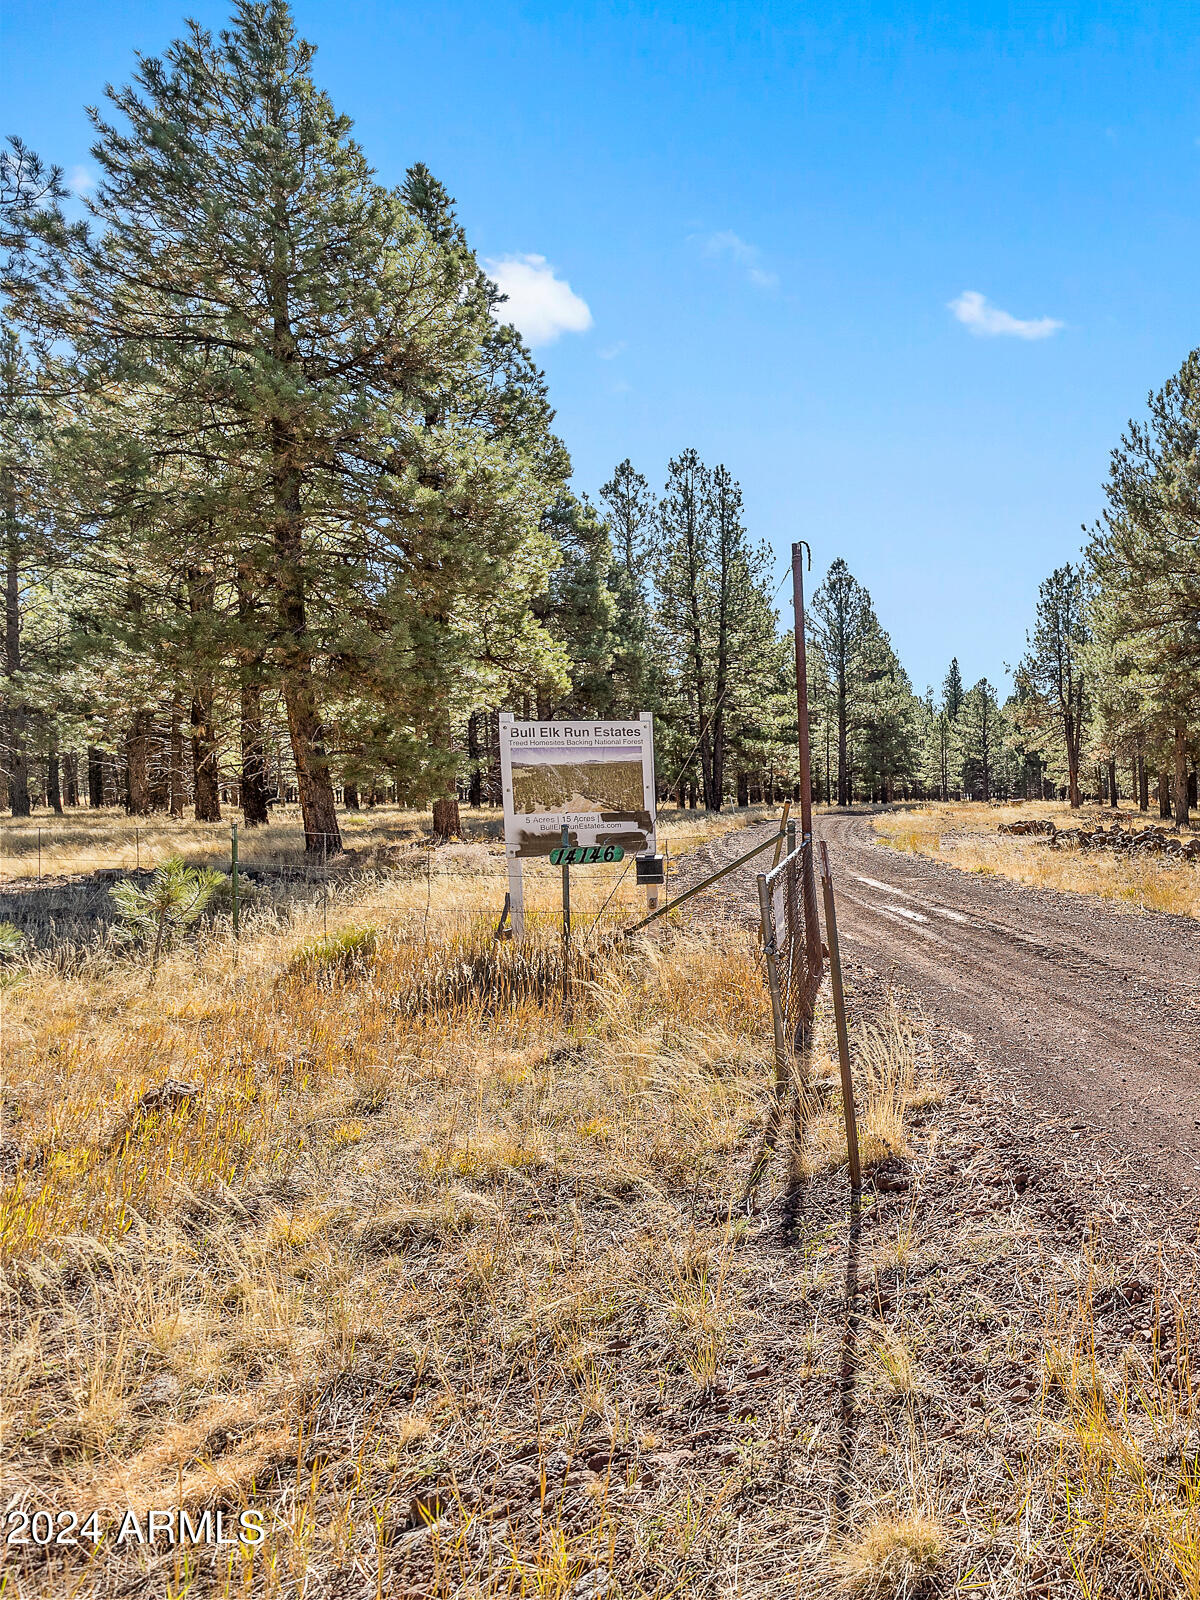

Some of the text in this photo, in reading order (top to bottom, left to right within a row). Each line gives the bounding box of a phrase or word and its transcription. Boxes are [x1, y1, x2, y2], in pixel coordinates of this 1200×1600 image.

[510, 726, 641, 738] Bull Elk Run Estates
[566, 739, 593, 747] Backing
[562, 815, 572, 823] 15
[573, 814, 596, 822] Acres
[555, 846, 616, 864] 14146
